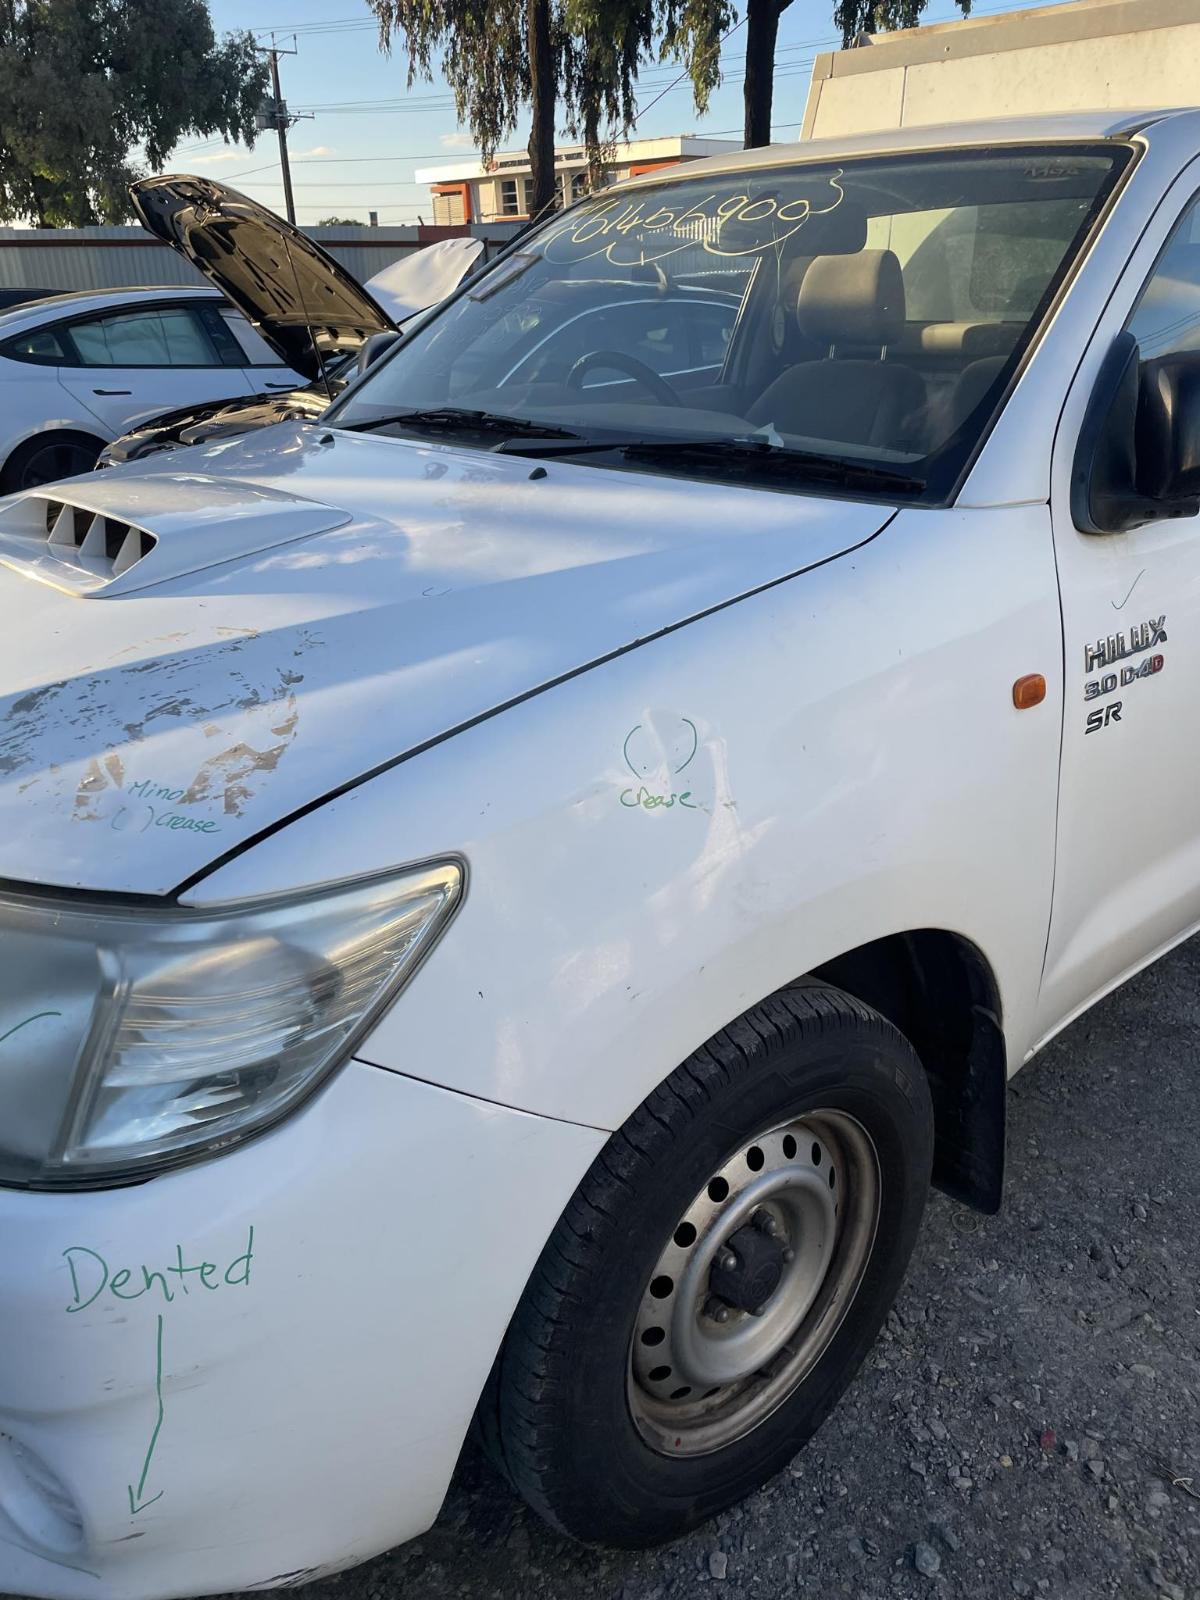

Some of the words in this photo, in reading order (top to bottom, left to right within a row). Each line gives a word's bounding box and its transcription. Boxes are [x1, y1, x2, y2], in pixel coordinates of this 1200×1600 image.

[1085, 615, 1168, 673] HILUX
[1120, 653, 1164, 687] D-4D
[1084, 700, 1123, 735] SR
[62, 1225, 254, 1314] Dented
